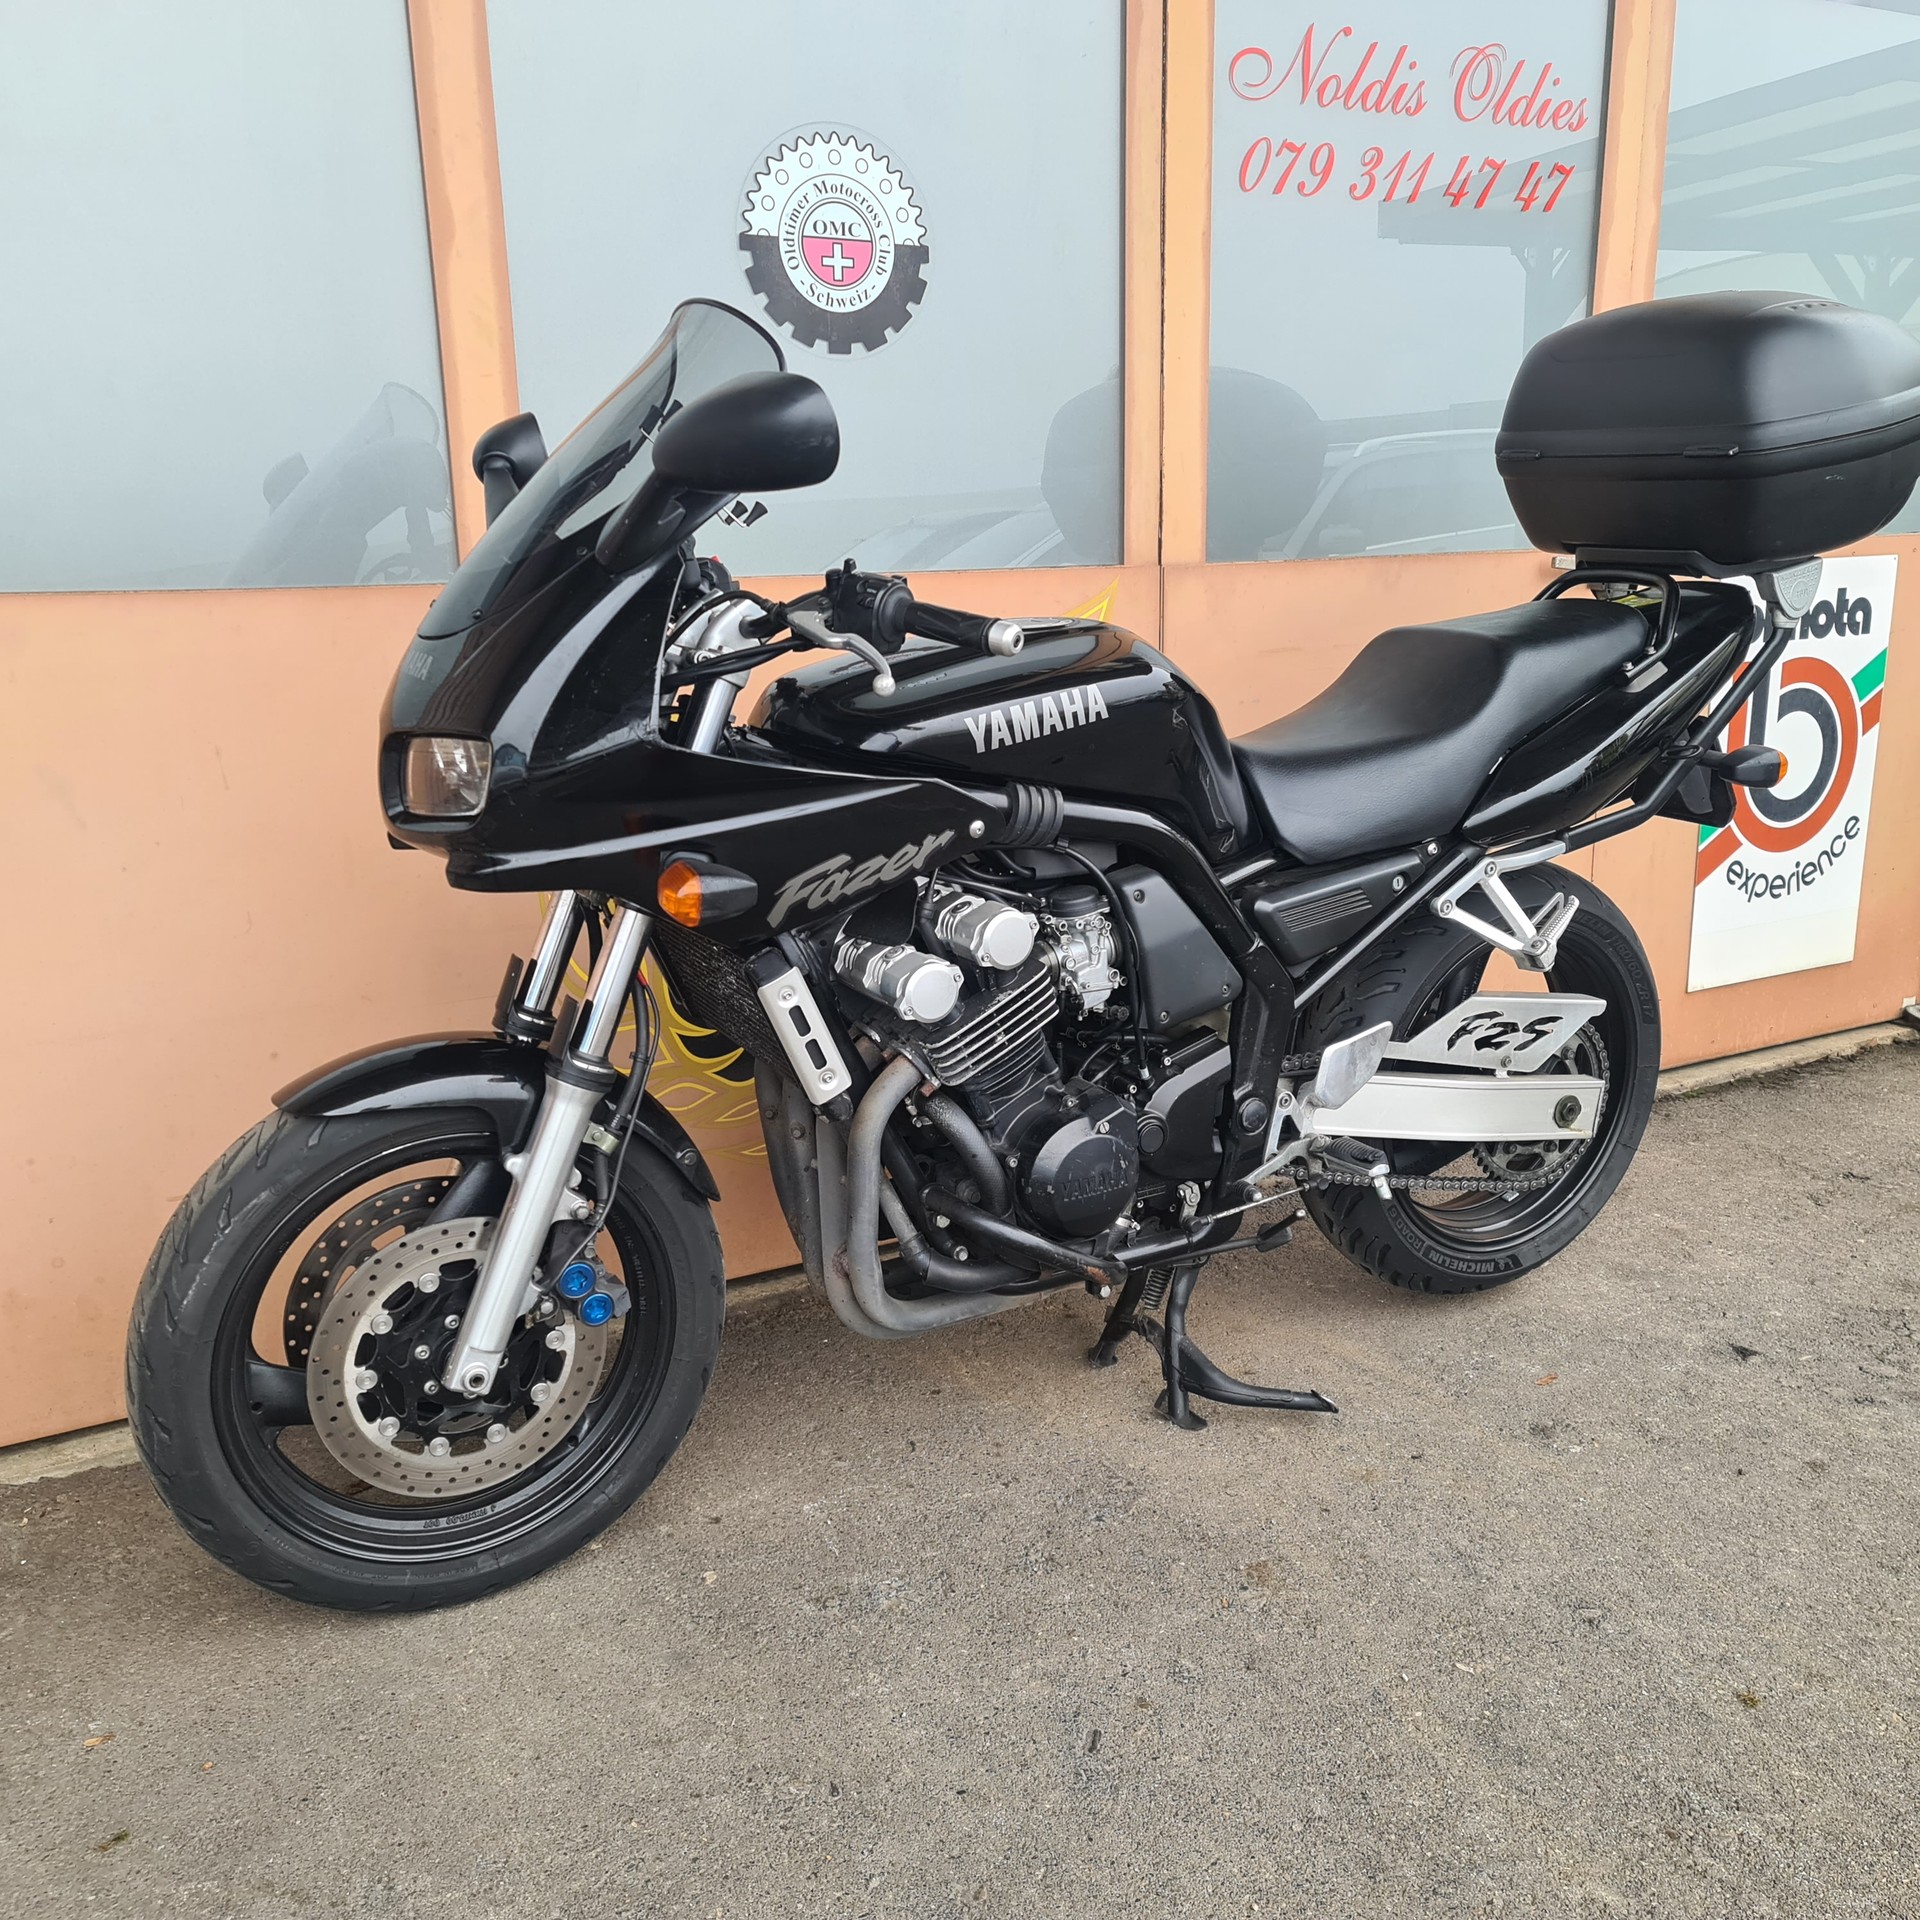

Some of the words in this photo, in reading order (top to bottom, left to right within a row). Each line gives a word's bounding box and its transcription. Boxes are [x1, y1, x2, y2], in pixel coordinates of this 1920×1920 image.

[1228, 22, 1428, 117] Noldis
[1449, 43, 1589, 132] Oldies
[1238, 136, 1335, 198] 079
[1348, 146, 1435, 204] 311
[1443, 155, 1507, 209] 47
[1513, 161, 1576, 213] 47
[783, 192, 810, 271] Oldtimer
[812, 180, 883, 229] Motocross
[875, 234, 891, 276] Club
[812, 219, 862, 238] OMC
[963, 683, 1110, 754] YAMAHA
[766, 828, 957, 929] Fazer
[1725, 815, 1861, 903] experience
[1061, 1171, 1129, 1202] YAMAHA
[1395, 1218, 1423, 1250] ROAD
[1427, 1251, 1496, 1274] MICHELIN
